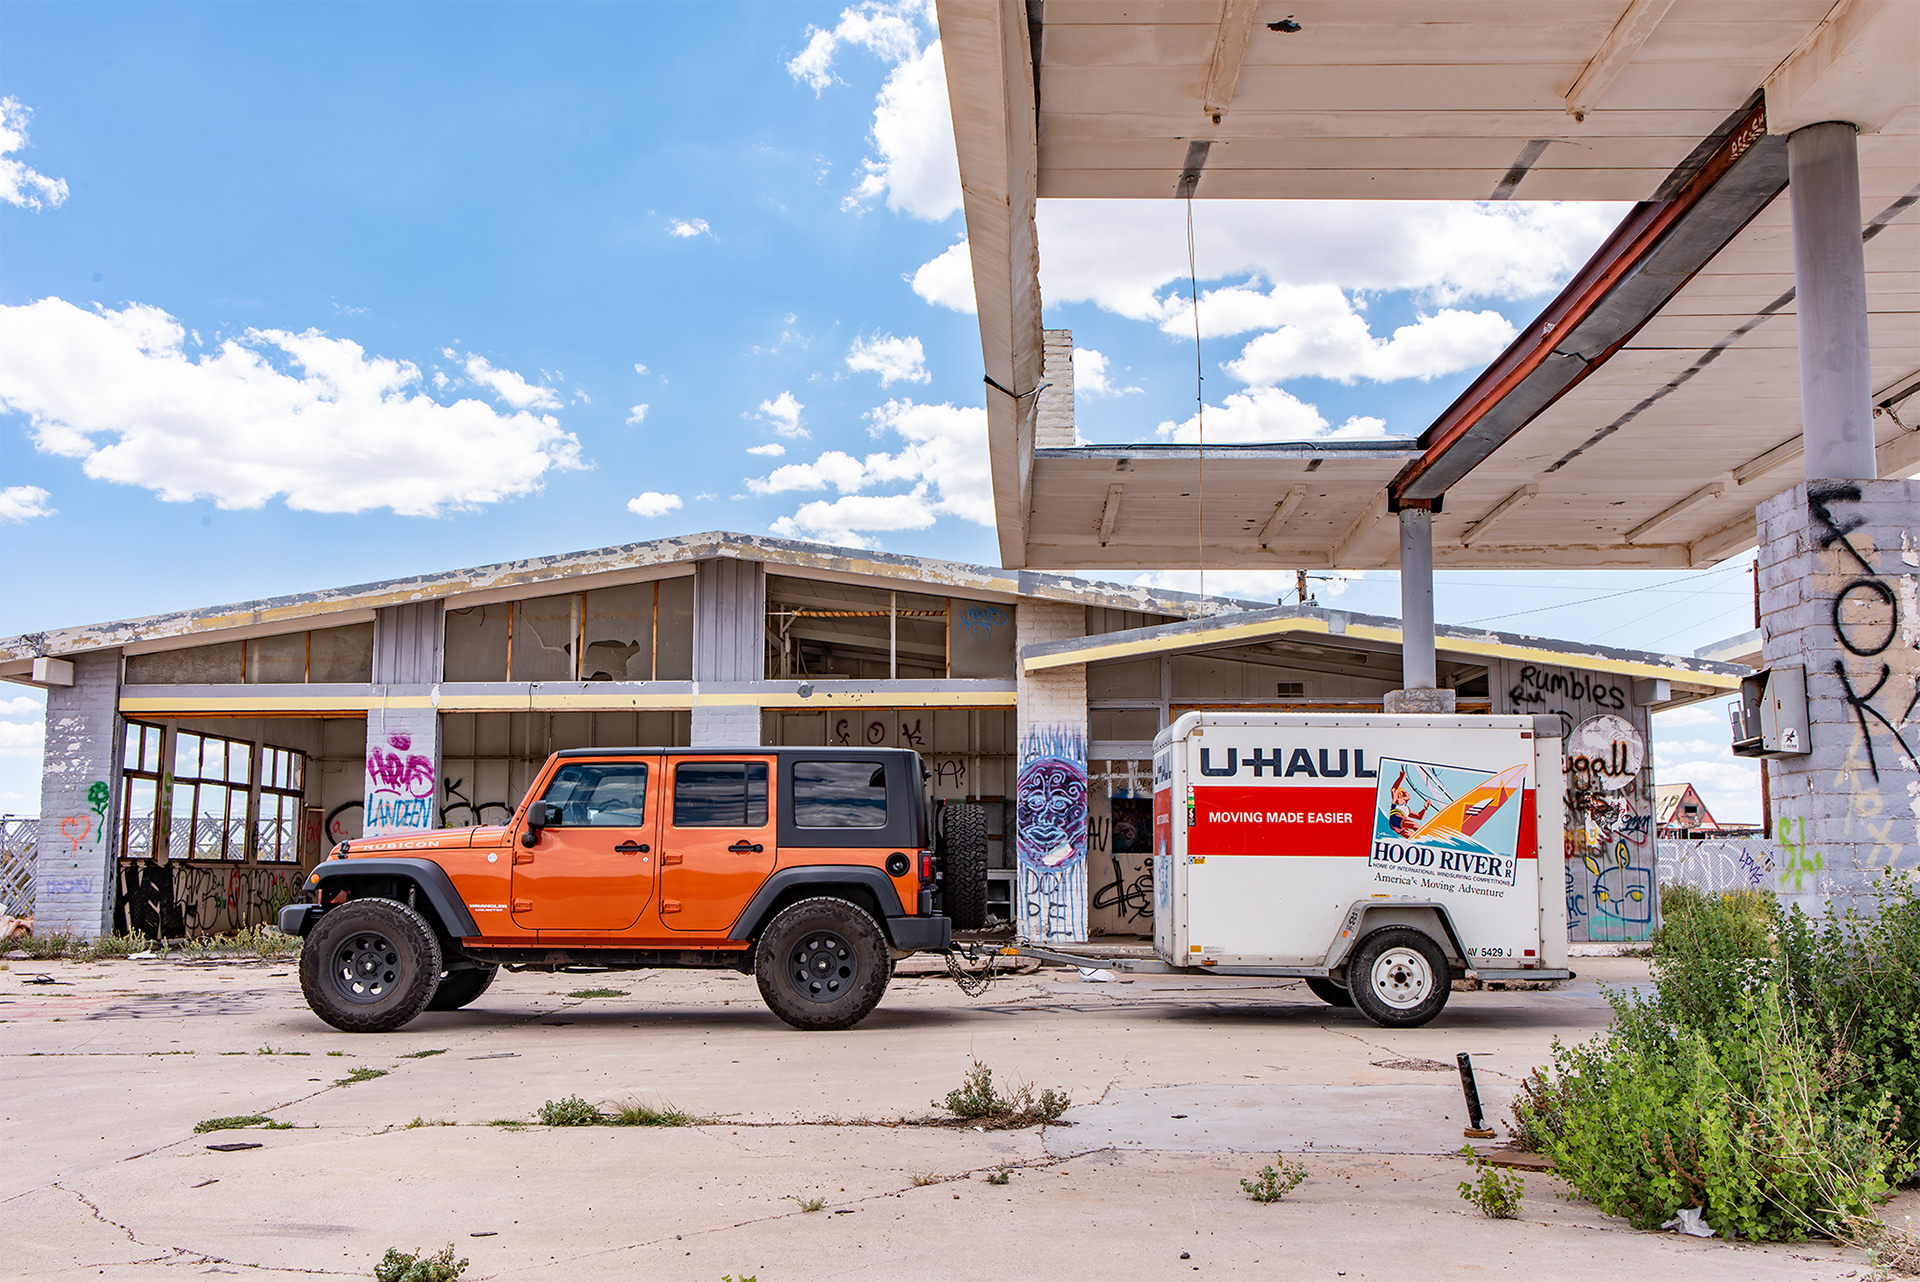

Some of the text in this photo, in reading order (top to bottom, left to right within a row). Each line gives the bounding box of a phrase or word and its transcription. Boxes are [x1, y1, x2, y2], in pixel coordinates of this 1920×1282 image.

[1520, 665, 1625, 710] Rumbles
[1200, 747, 1377, 778] U-HAUL
[1209, 812, 1353, 824] MOVING MADE EASIER
[363, 841, 440, 851] RUBICON
[1373, 841, 1503, 878] HOOD RIVER
[1372, 862, 1388, 870] HOME
[1396, 865, 1436, 877] INTERNATIONAL
[1436, 871, 1472, 881] WINDSURFING
[1472, 875, 1511, 887] COMPETITIONS
[1374, 872, 1505, 898] America's Moving Adventure
[1481, 947, 1504, 957] 5429
[1506, 947, 1512, 957] J
